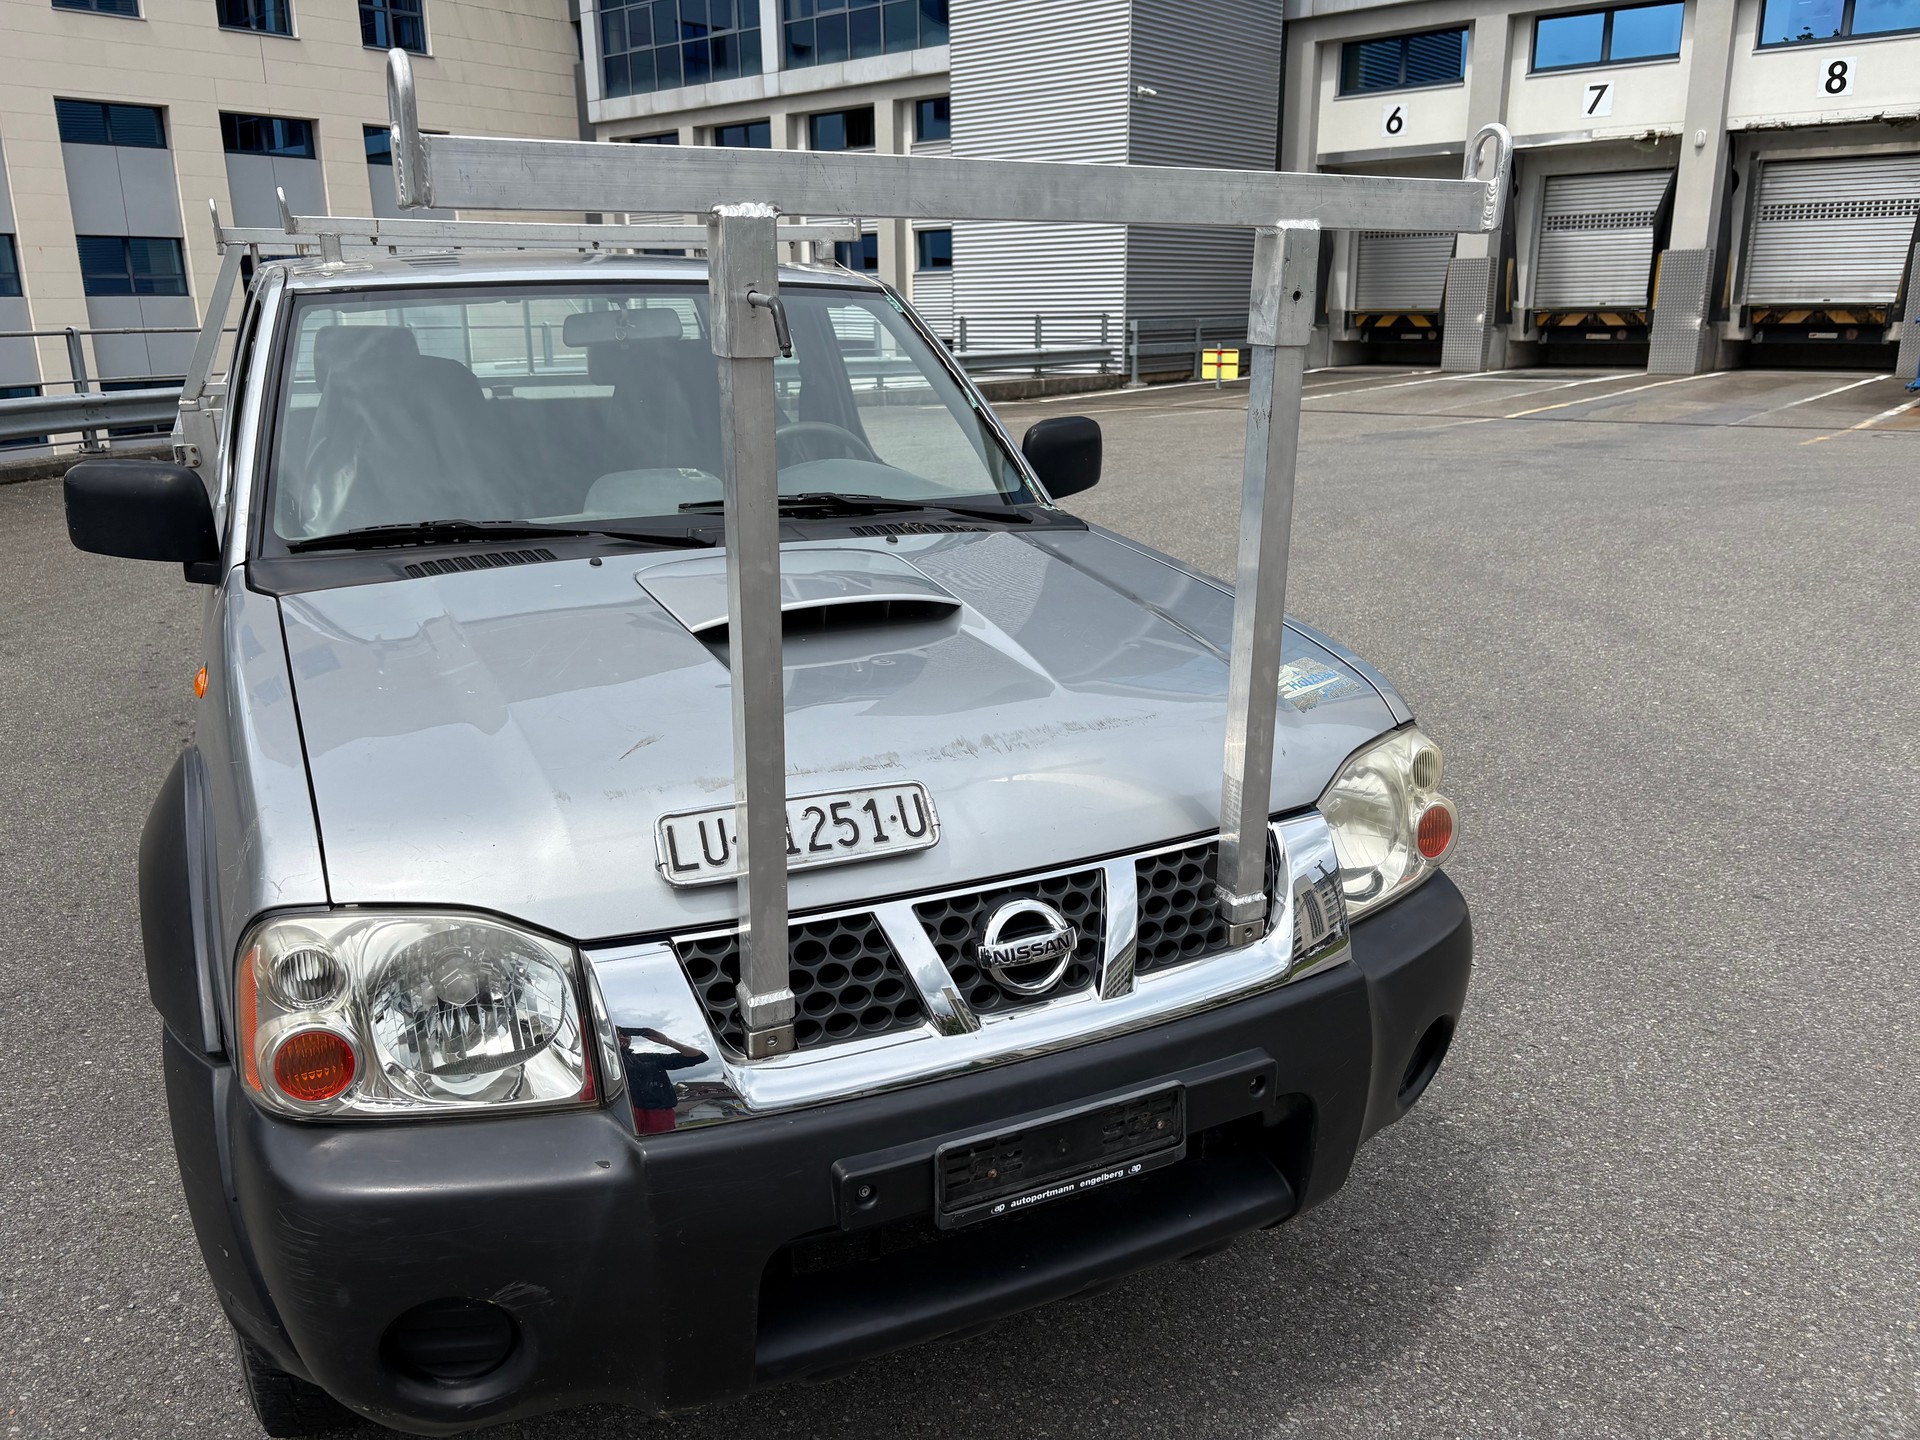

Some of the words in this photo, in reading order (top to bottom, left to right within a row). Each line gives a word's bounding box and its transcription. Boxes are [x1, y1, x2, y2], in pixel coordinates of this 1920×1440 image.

[1825, 60, 1848, 94] 8
[1587, 84, 1609, 115] 7
[1386, 106, 1403, 134] 6
[993, 934, 1070, 964] NISSAN
[1010, 1183, 1075, 1208] autoportmann
[1079, 1169, 1124, 1189] engelberg
